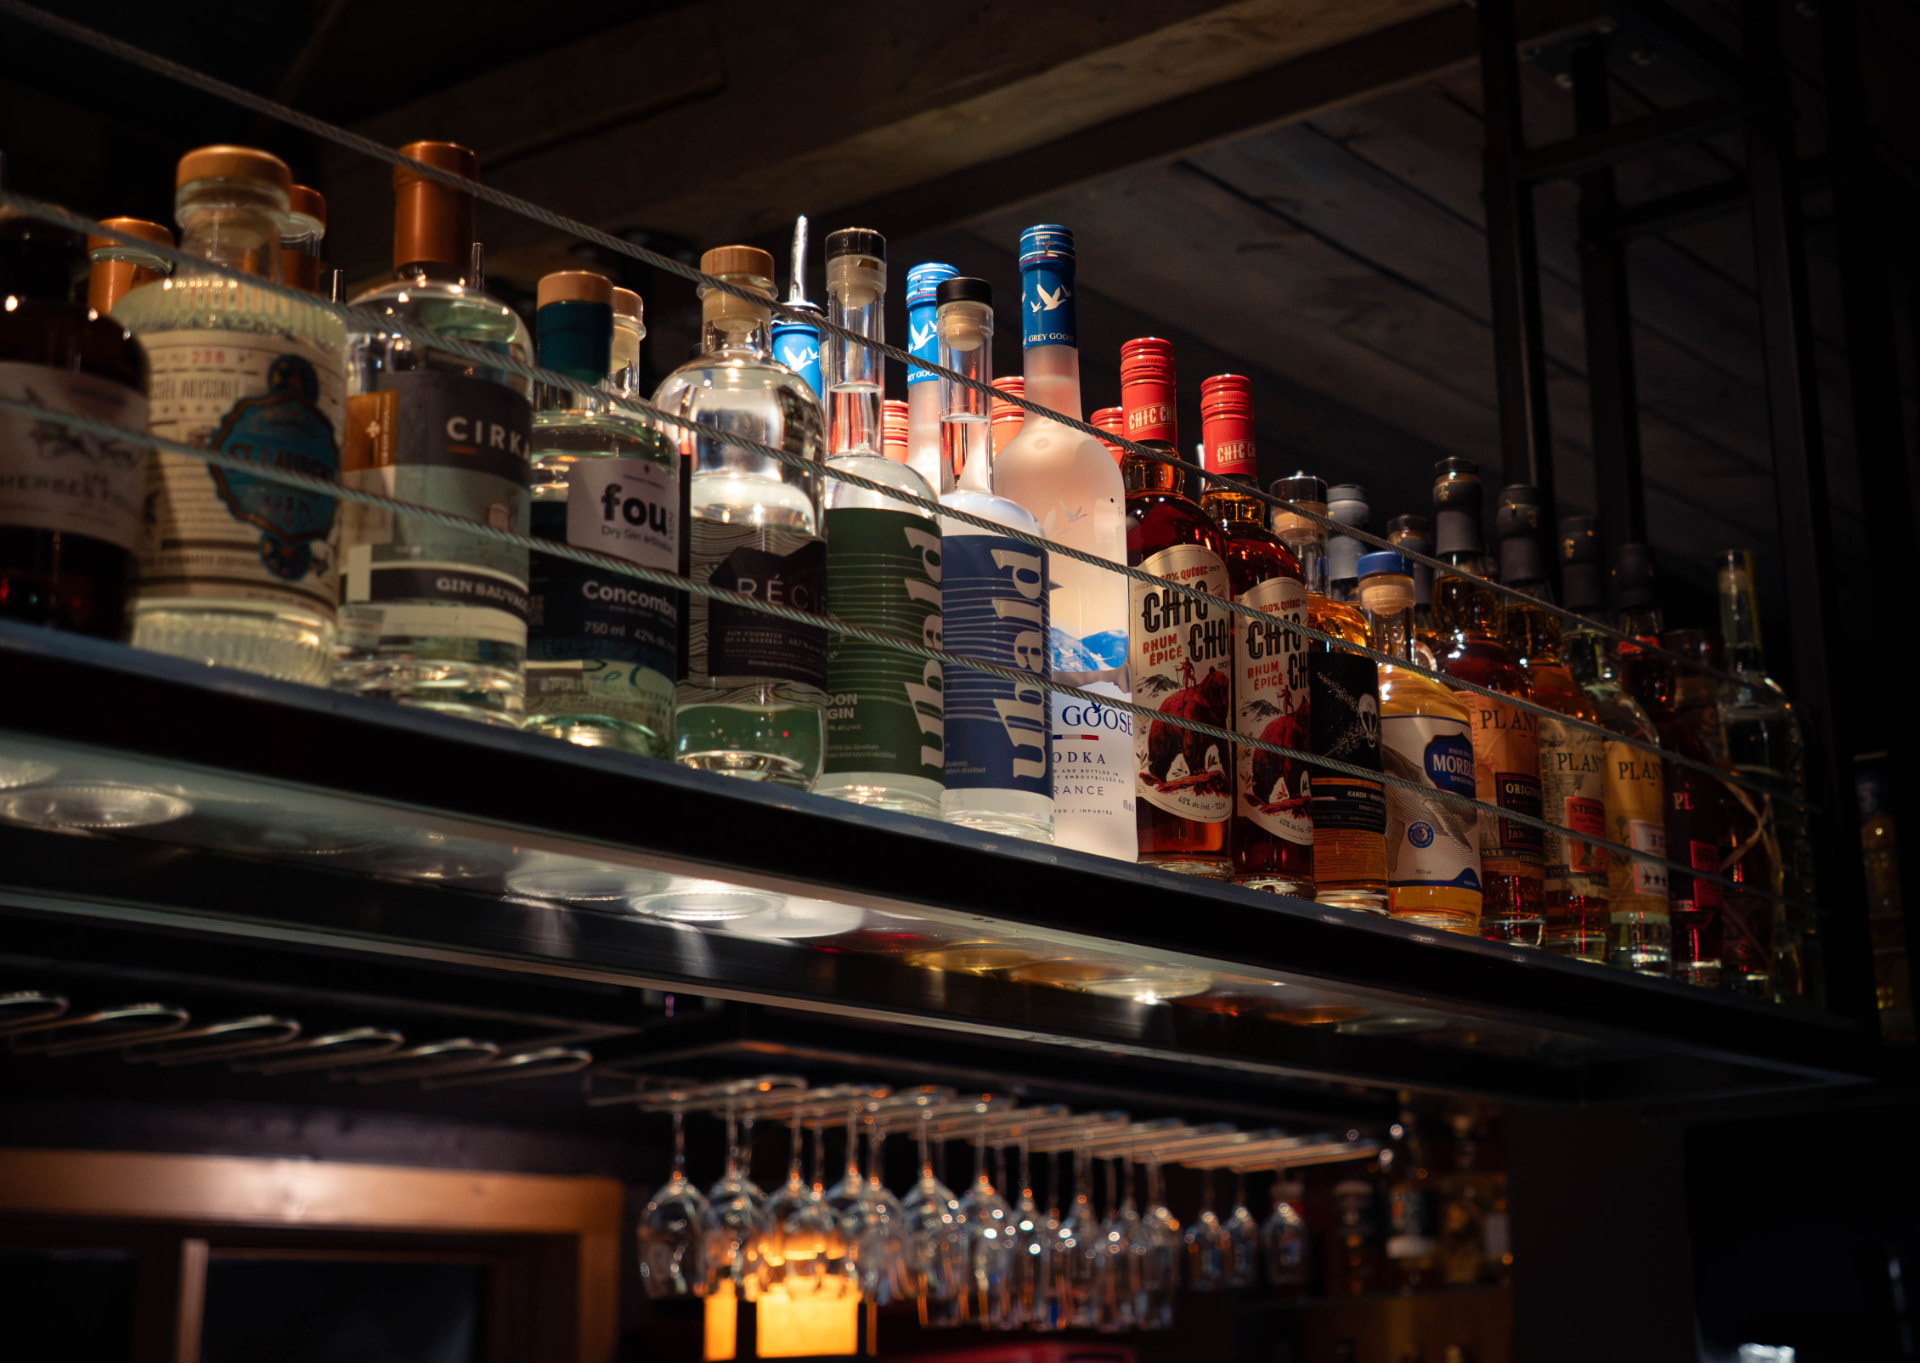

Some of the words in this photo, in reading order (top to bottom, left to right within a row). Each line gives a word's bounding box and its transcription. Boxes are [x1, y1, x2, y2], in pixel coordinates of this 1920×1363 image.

[1028, 333, 1048, 343] GREY
[1049, 332, 1075, 341] GOO
[916, 369, 939, 379] GOO
[1129, 407, 1157, 430] CHIC
[1217, 443, 1245, 463] CHIC
[601, 483, 667, 536] fou
[602, 526, 621, 539] Dry
[1180, 565, 1208, 580] QUÉBEC
[436, 577, 473, 593] GIN
[1142, 580, 1208, 634] CHIC
[1143, 633, 1178, 655] RHUM
[1246, 612, 1301, 660] CHIC
[990, 547, 1046, 779] ubald
[1149, 645, 1183, 667] ÉPICÉ
[1247, 661, 1279, 680] RHUM
[1253, 672, 1284, 691] ÉPICÉ
[827, 693, 858, 706] DON
[828, 708, 855, 720] GIN
[1062, 704, 1133, 737] GOOSE
[1052, 751, 1106, 765] ODKA
[1053, 785, 1105, 796] RANCE
[1178, 796, 1191, 806] 40%
